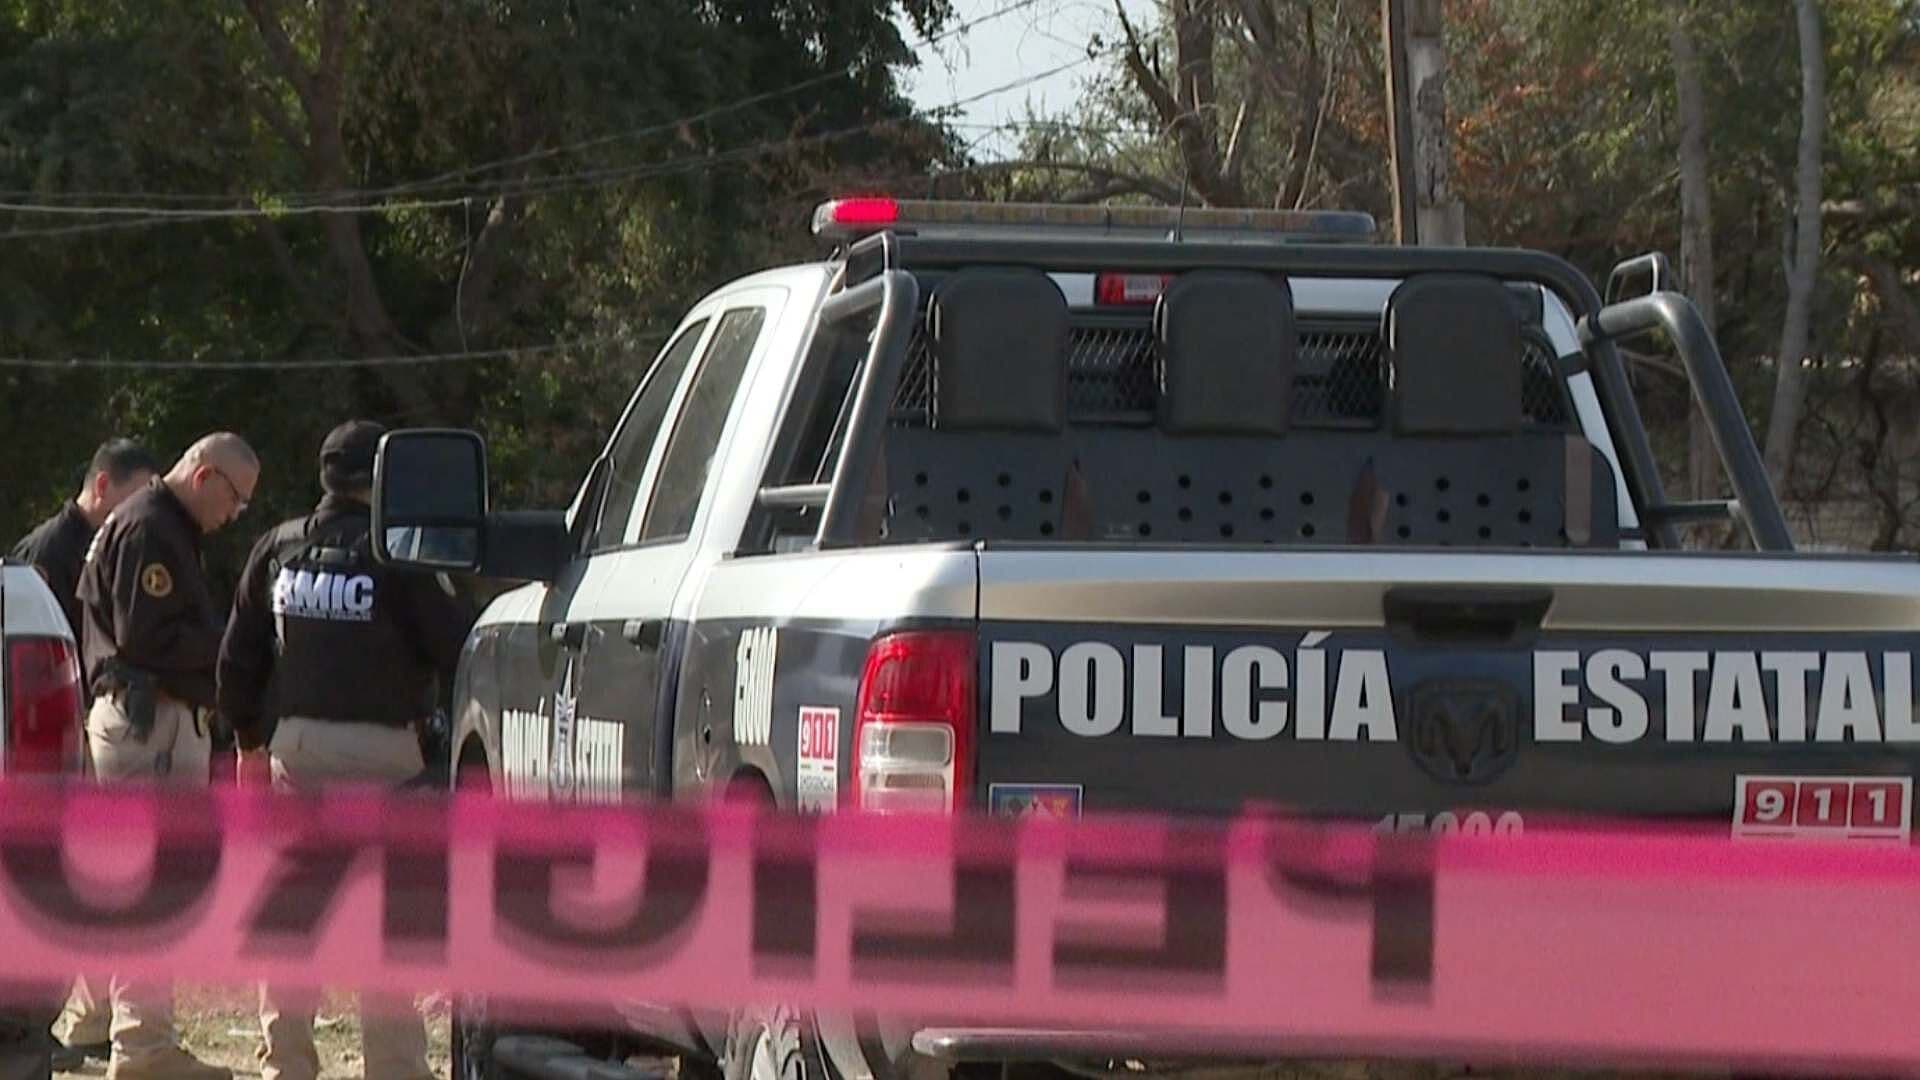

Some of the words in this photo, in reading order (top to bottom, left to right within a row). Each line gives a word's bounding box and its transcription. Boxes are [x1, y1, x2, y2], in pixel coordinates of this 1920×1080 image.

[990, 631, 1398, 741] POLICÍA
[1533, 649, 1920, 744] ESTATAL
[802, 716, 834, 754] 911
[1752, 786, 1892, 823] 911
